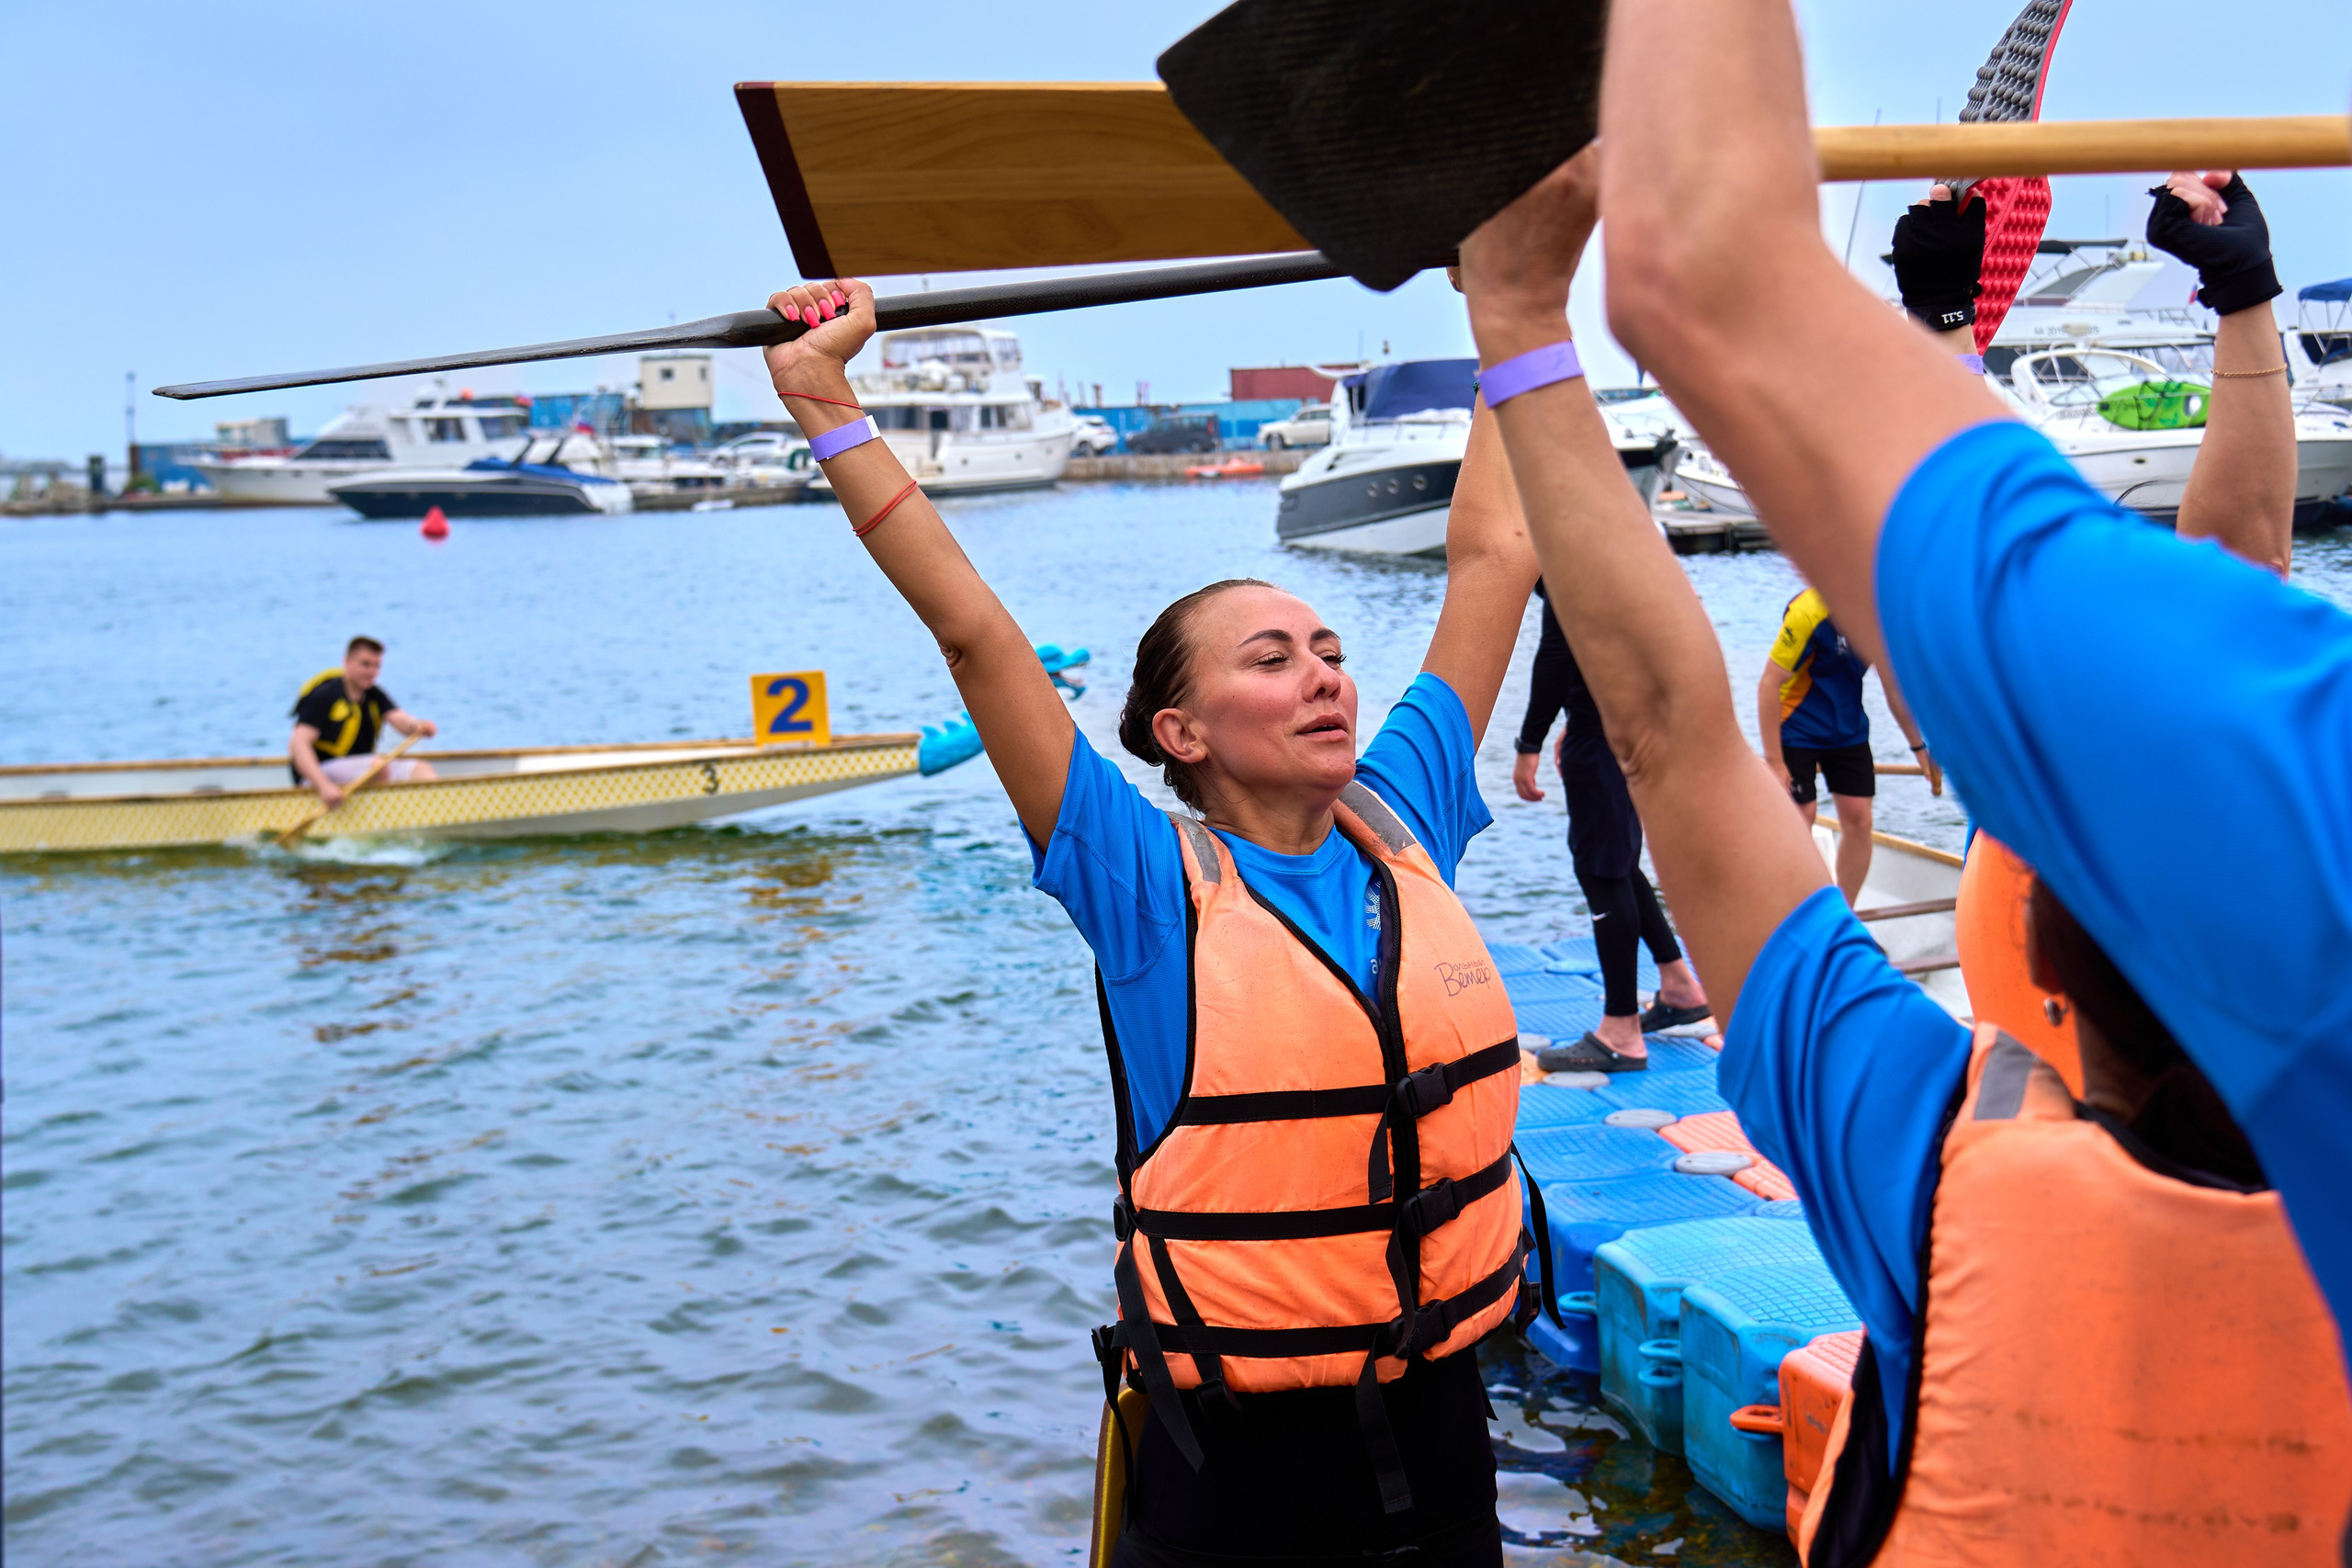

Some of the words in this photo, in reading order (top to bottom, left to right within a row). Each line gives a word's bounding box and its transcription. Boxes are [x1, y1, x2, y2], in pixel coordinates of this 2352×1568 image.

[1941, 310, 1964, 324] 5.11
[766, 677, 813, 733] 2
[702, 763, 719, 795] 3
